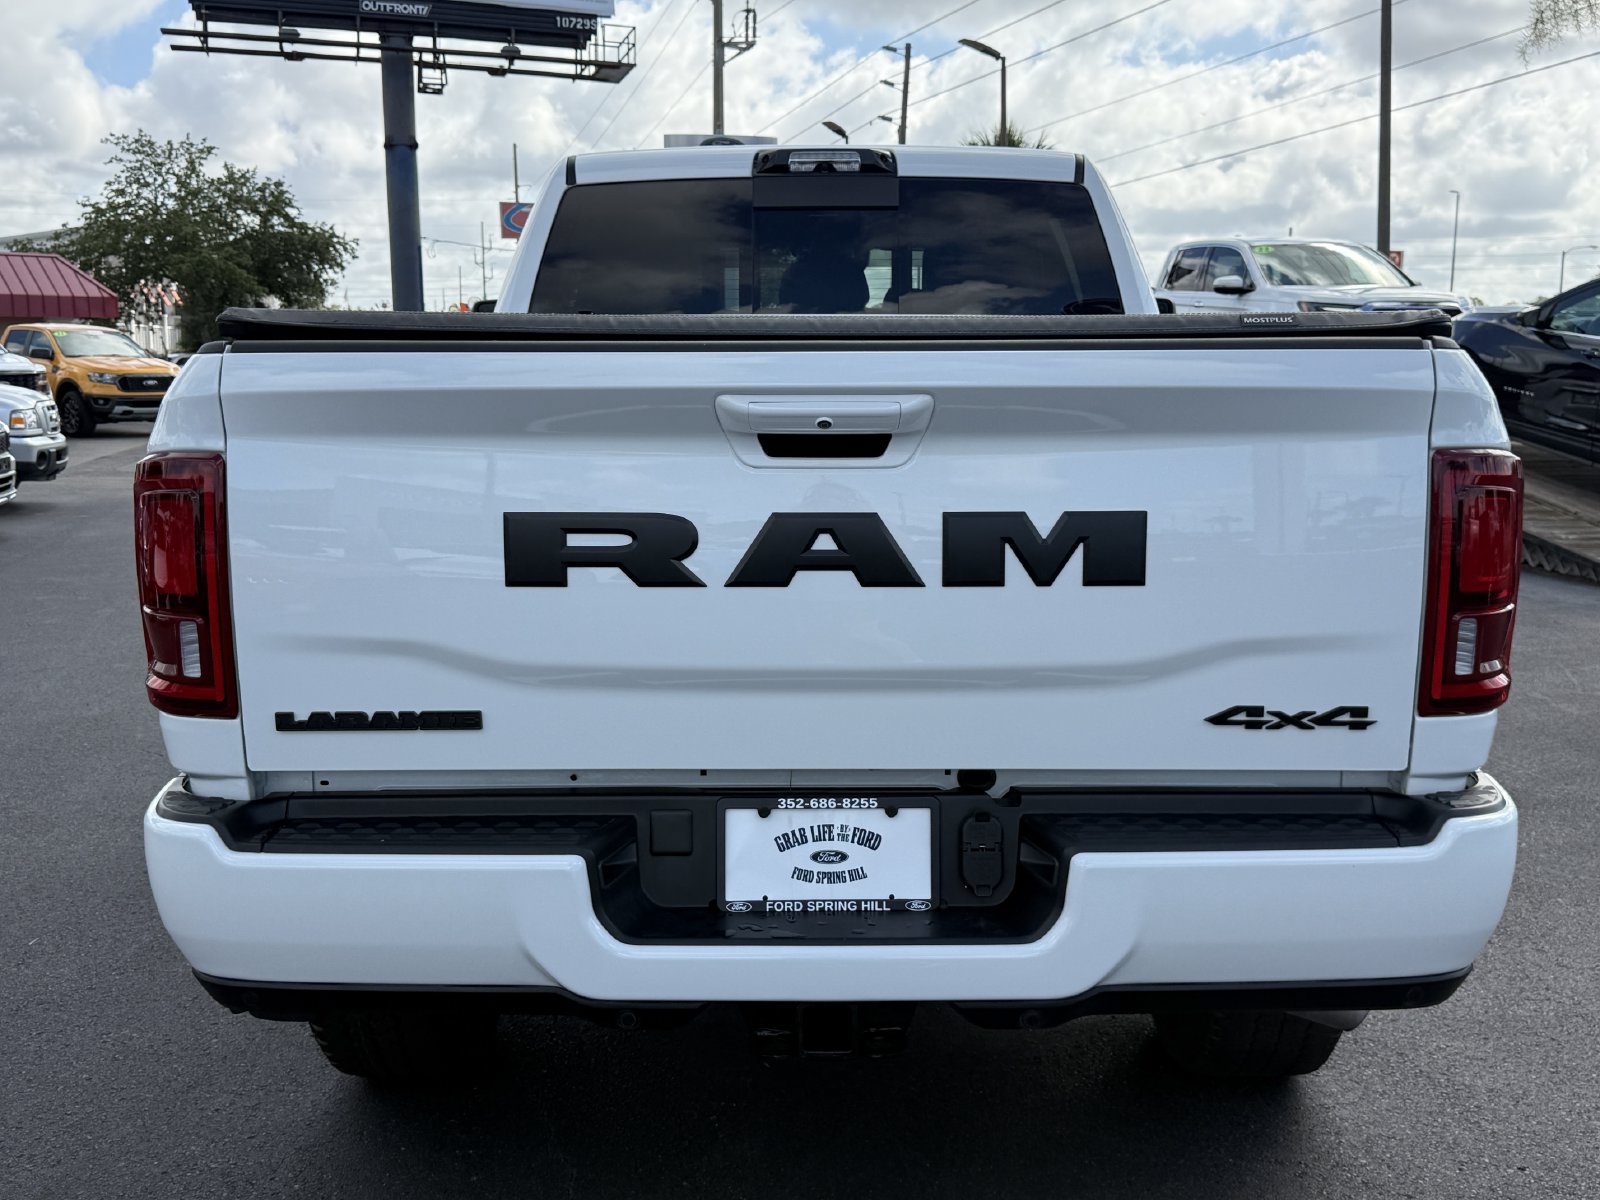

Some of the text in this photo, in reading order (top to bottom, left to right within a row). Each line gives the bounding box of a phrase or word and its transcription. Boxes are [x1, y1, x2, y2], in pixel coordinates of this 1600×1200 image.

[503, 511, 1148, 588] RAM
[777, 797, 878, 809] 352-686-8255
[773, 827, 809, 853] GRAB
[809, 823, 835, 843] LIFE
[836, 833, 850, 843] THE
[850, 826, 882, 851] FORD
[817, 851, 841, 862] Ford
[790, 866, 868, 885] FORD SPRING HILL
[766, 901, 891, 912] FORD SPRING HILL
